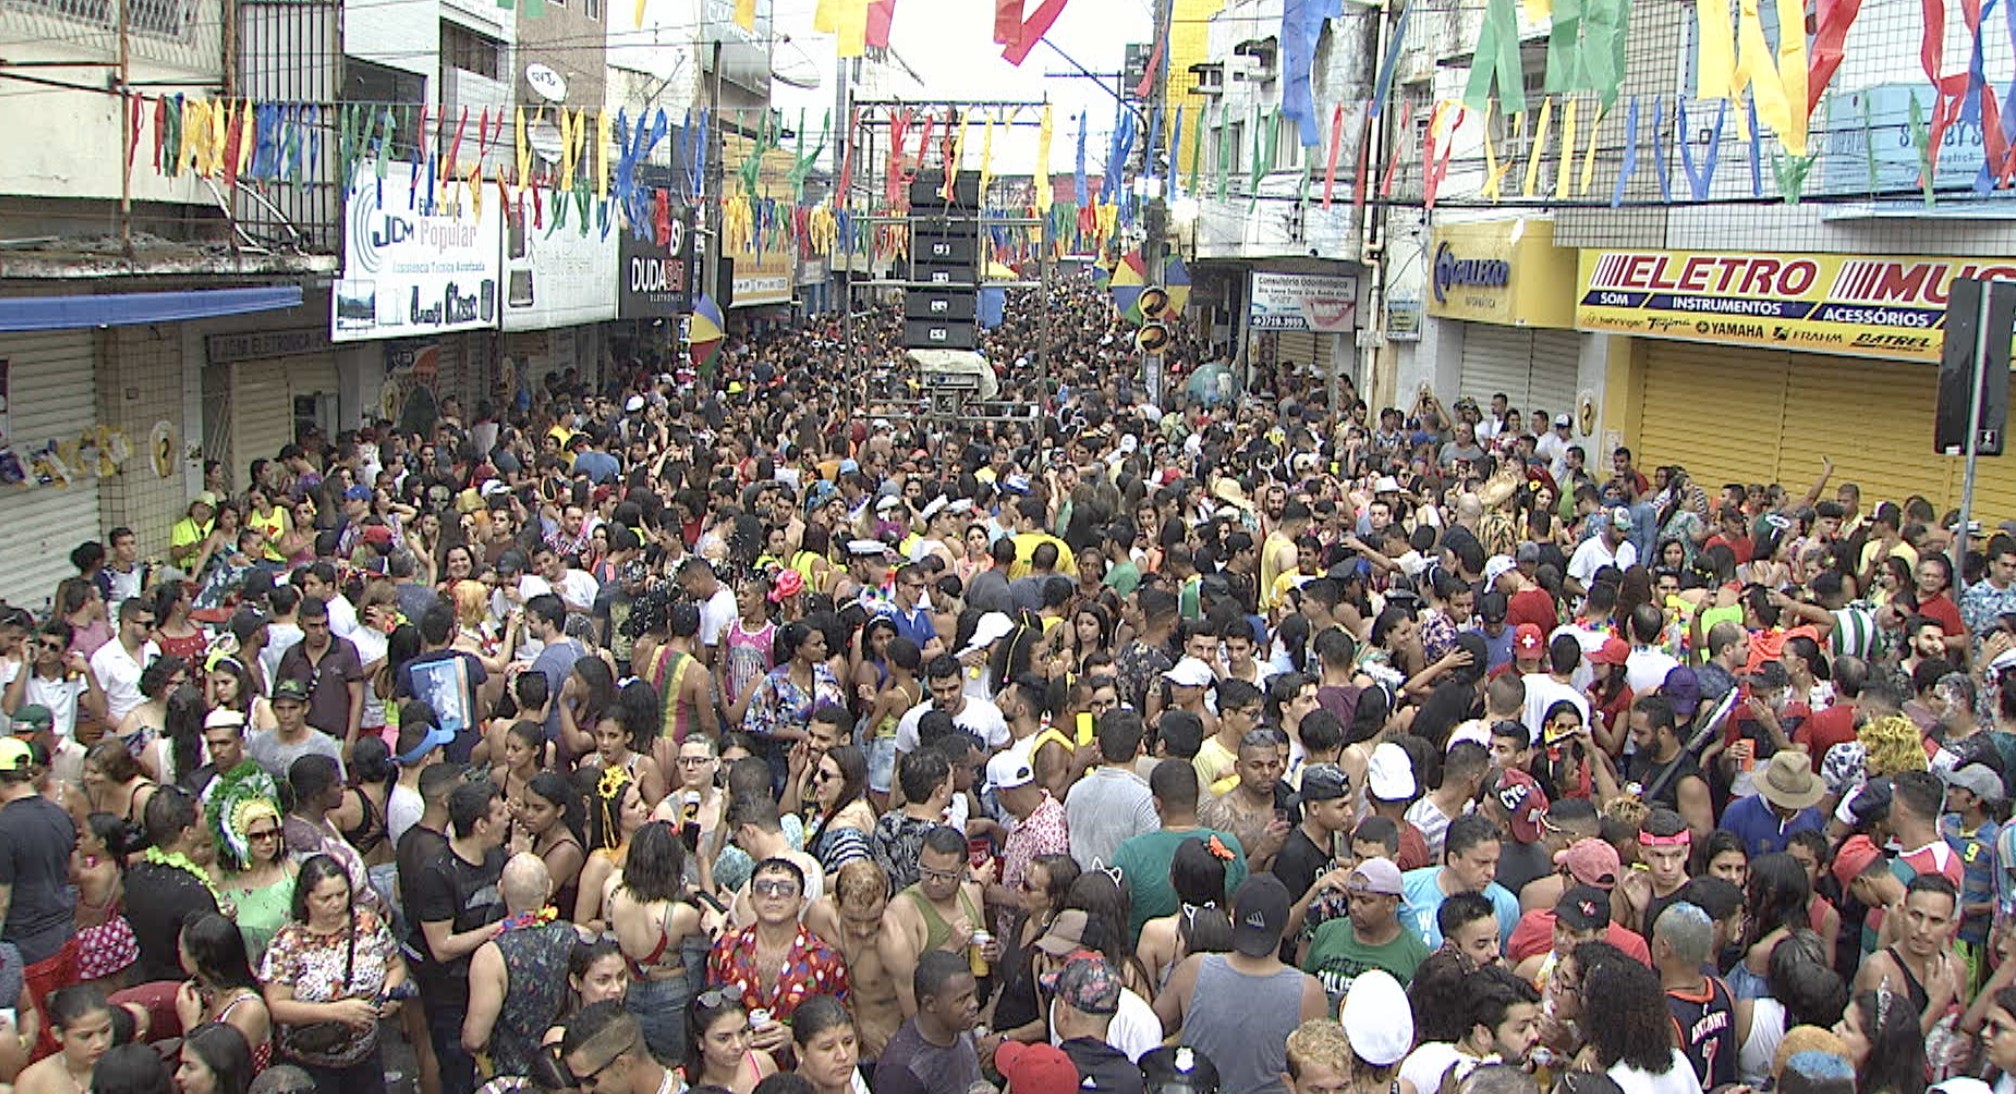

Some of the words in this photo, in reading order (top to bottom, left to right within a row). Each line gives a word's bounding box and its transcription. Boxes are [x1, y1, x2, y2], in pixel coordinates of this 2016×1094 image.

[372, 214, 414, 247] JDM
[419, 219, 477, 255] Popular
[1621, 254, 1818, 296] ELETRO
[1600, 291, 1628, 306] SOM
[1673, 296, 1782, 316] INSTRUMENTOS
[1823, 307, 1929, 327] ACESSÓRIOS
[1711, 322, 1764, 339] YAMAHA
[1964, 842, 1980, 862] 9
[1701, 1036, 1718, 1091] 7
